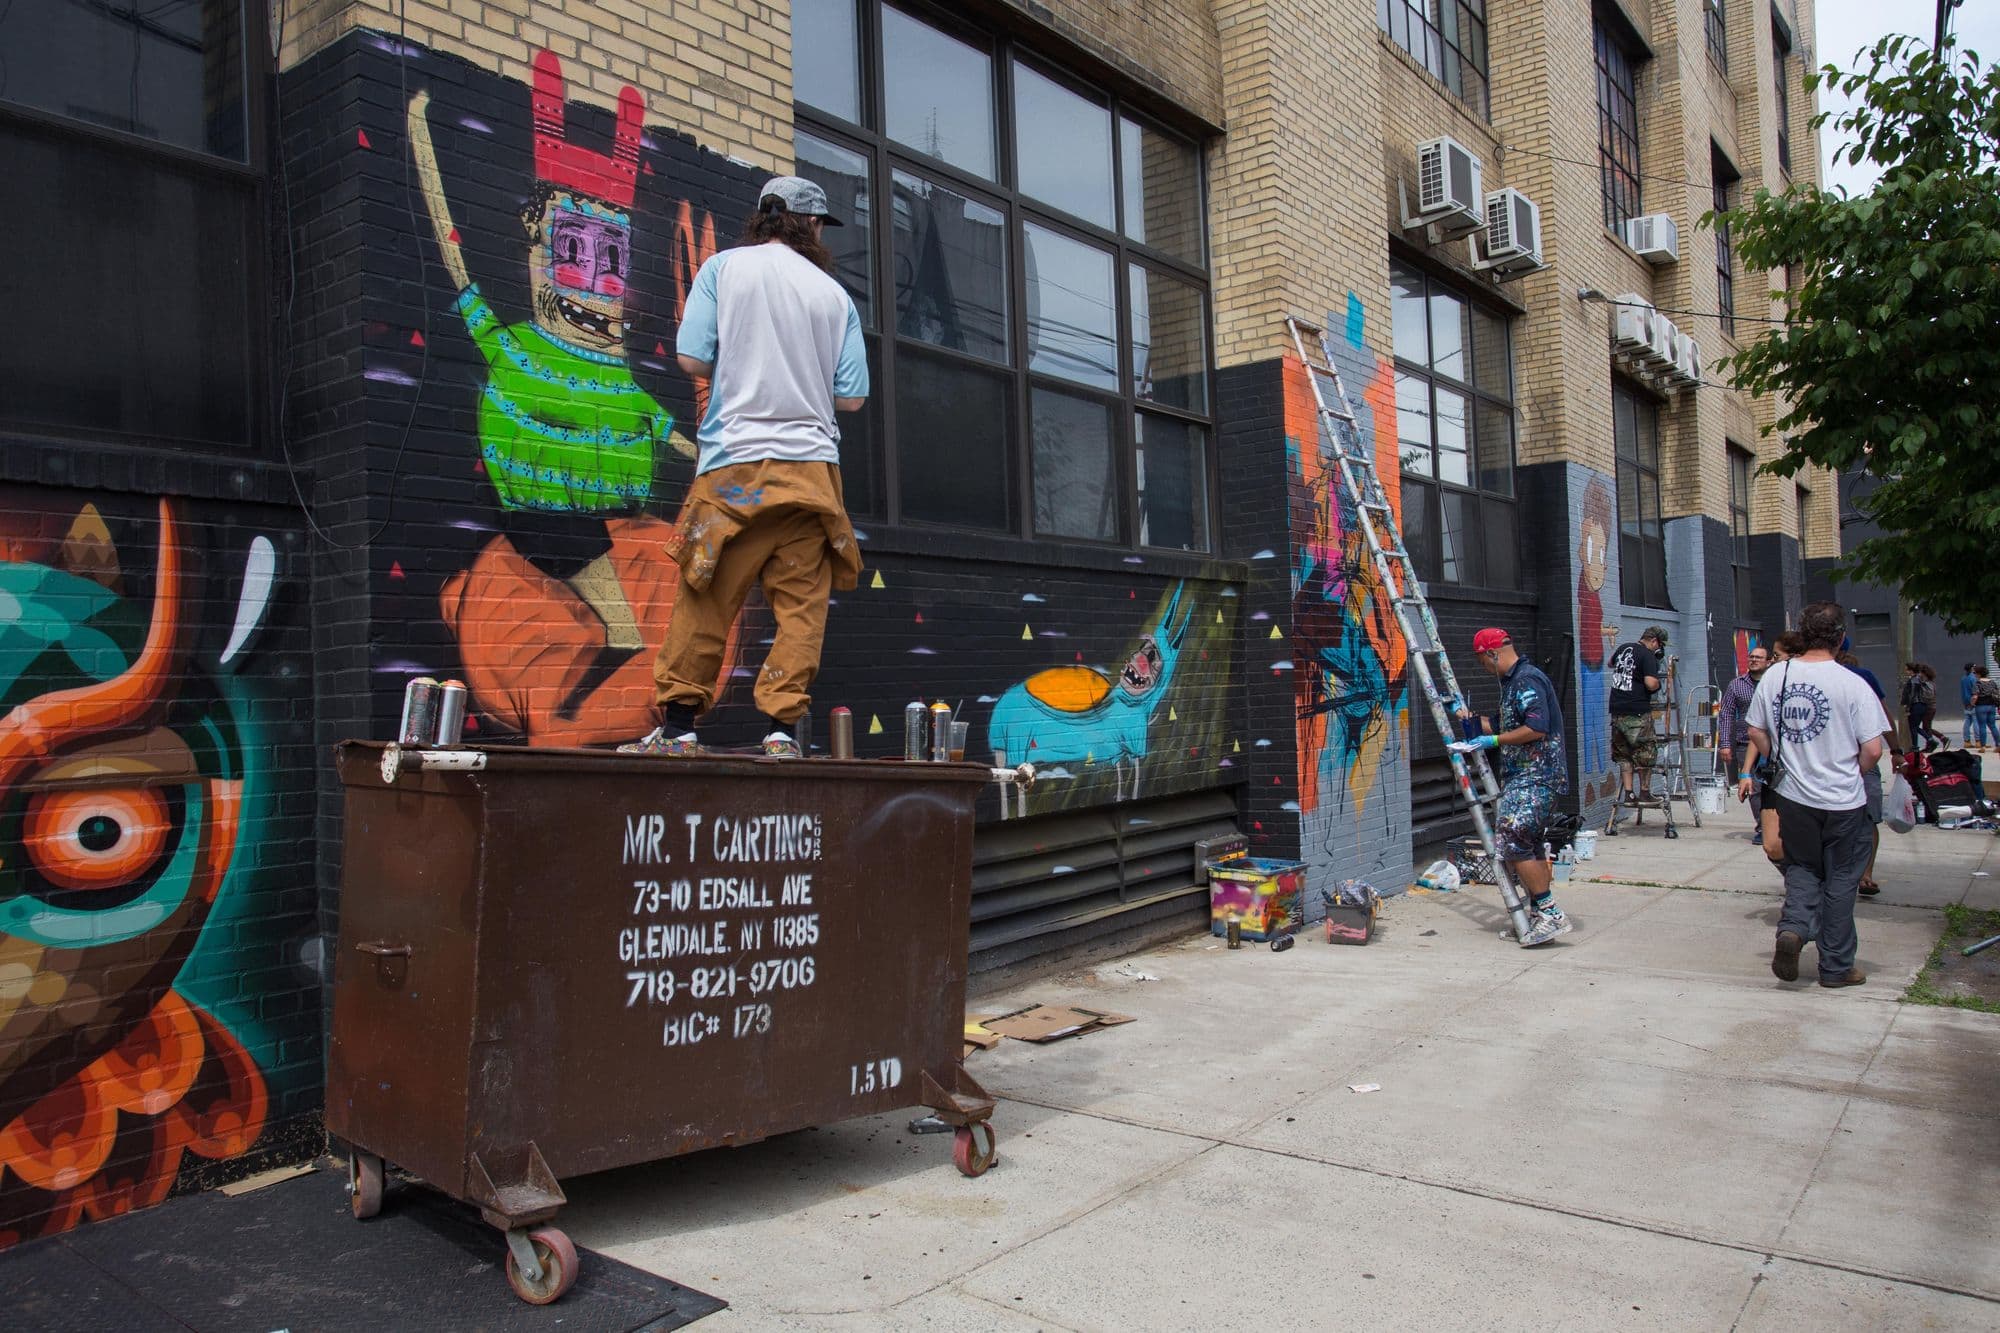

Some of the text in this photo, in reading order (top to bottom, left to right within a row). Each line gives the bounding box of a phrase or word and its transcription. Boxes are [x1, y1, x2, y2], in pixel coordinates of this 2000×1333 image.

[1784, 706, 1811, 720] UAW
[622, 814, 812, 864] MR. T CARTING
[632, 874, 813, 914] 73-10 EDSALL AVE
[740, 919, 764, 951] NY
[772, 913, 820, 949] 11385
[625, 955, 816, 1007] 718-821-9706
[663, 1003, 773, 1047] BIC# 173
[850, 1056, 902, 1097] 1.5 YD
